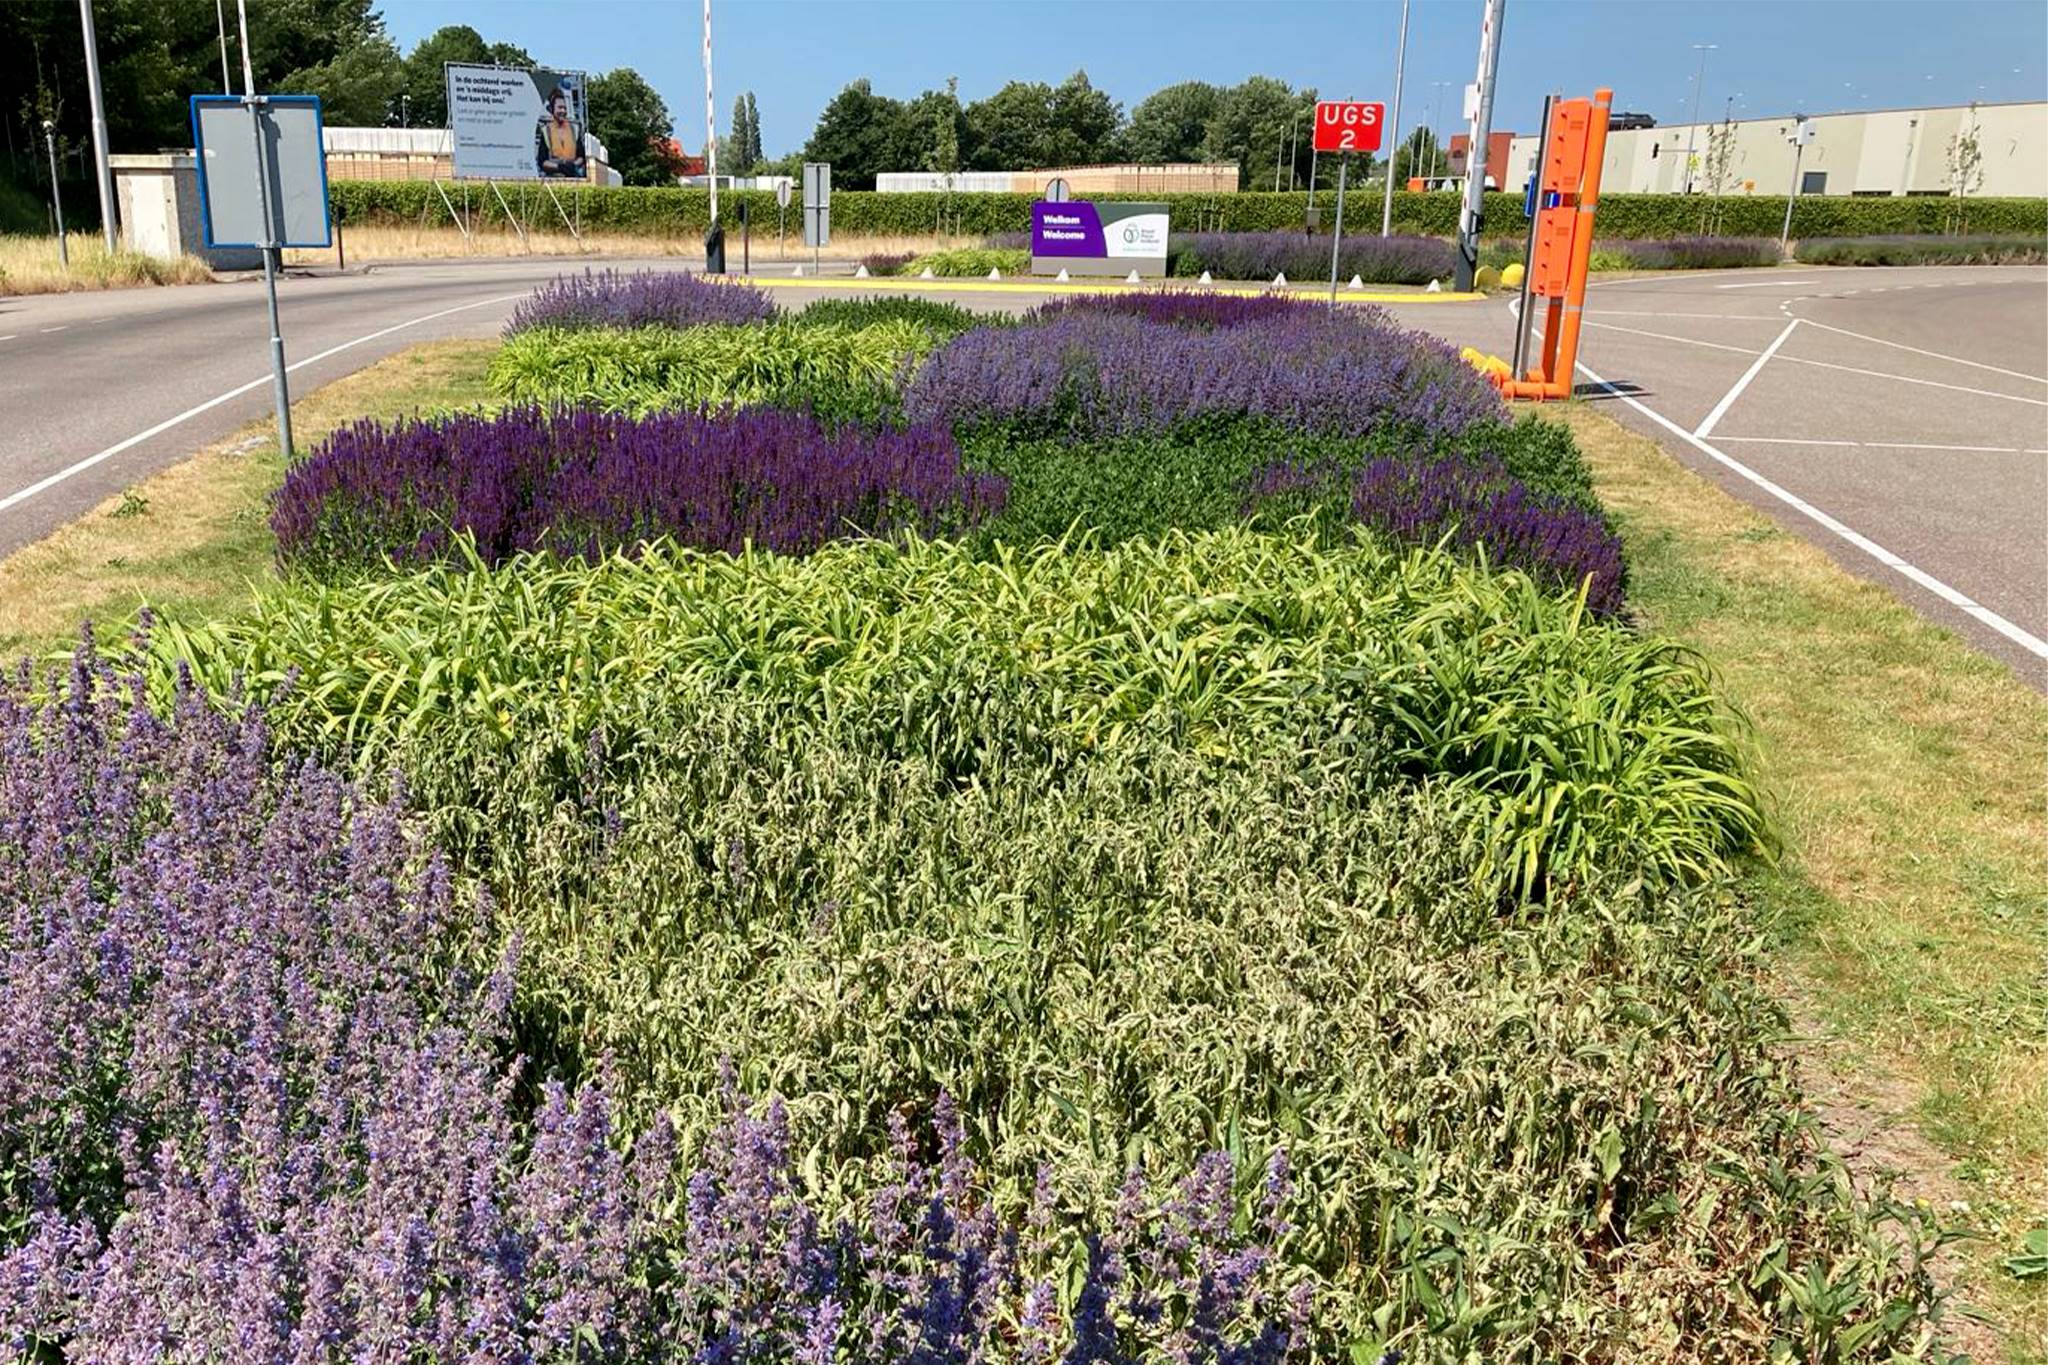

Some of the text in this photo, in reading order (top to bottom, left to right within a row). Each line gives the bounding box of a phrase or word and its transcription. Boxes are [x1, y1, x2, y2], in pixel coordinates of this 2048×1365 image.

[473, 77, 499, 85] ochtend
[501, 78, 524, 86] werken
[472, 87, 499, 95] middags
[482, 96, 490, 104] bij
[1324, 105, 1376, 125] UGS
[1339, 129, 1355, 149] 2
[1043, 214, 1080, 224] Welkom
[1043, 229, 1085, 240] Welcome
